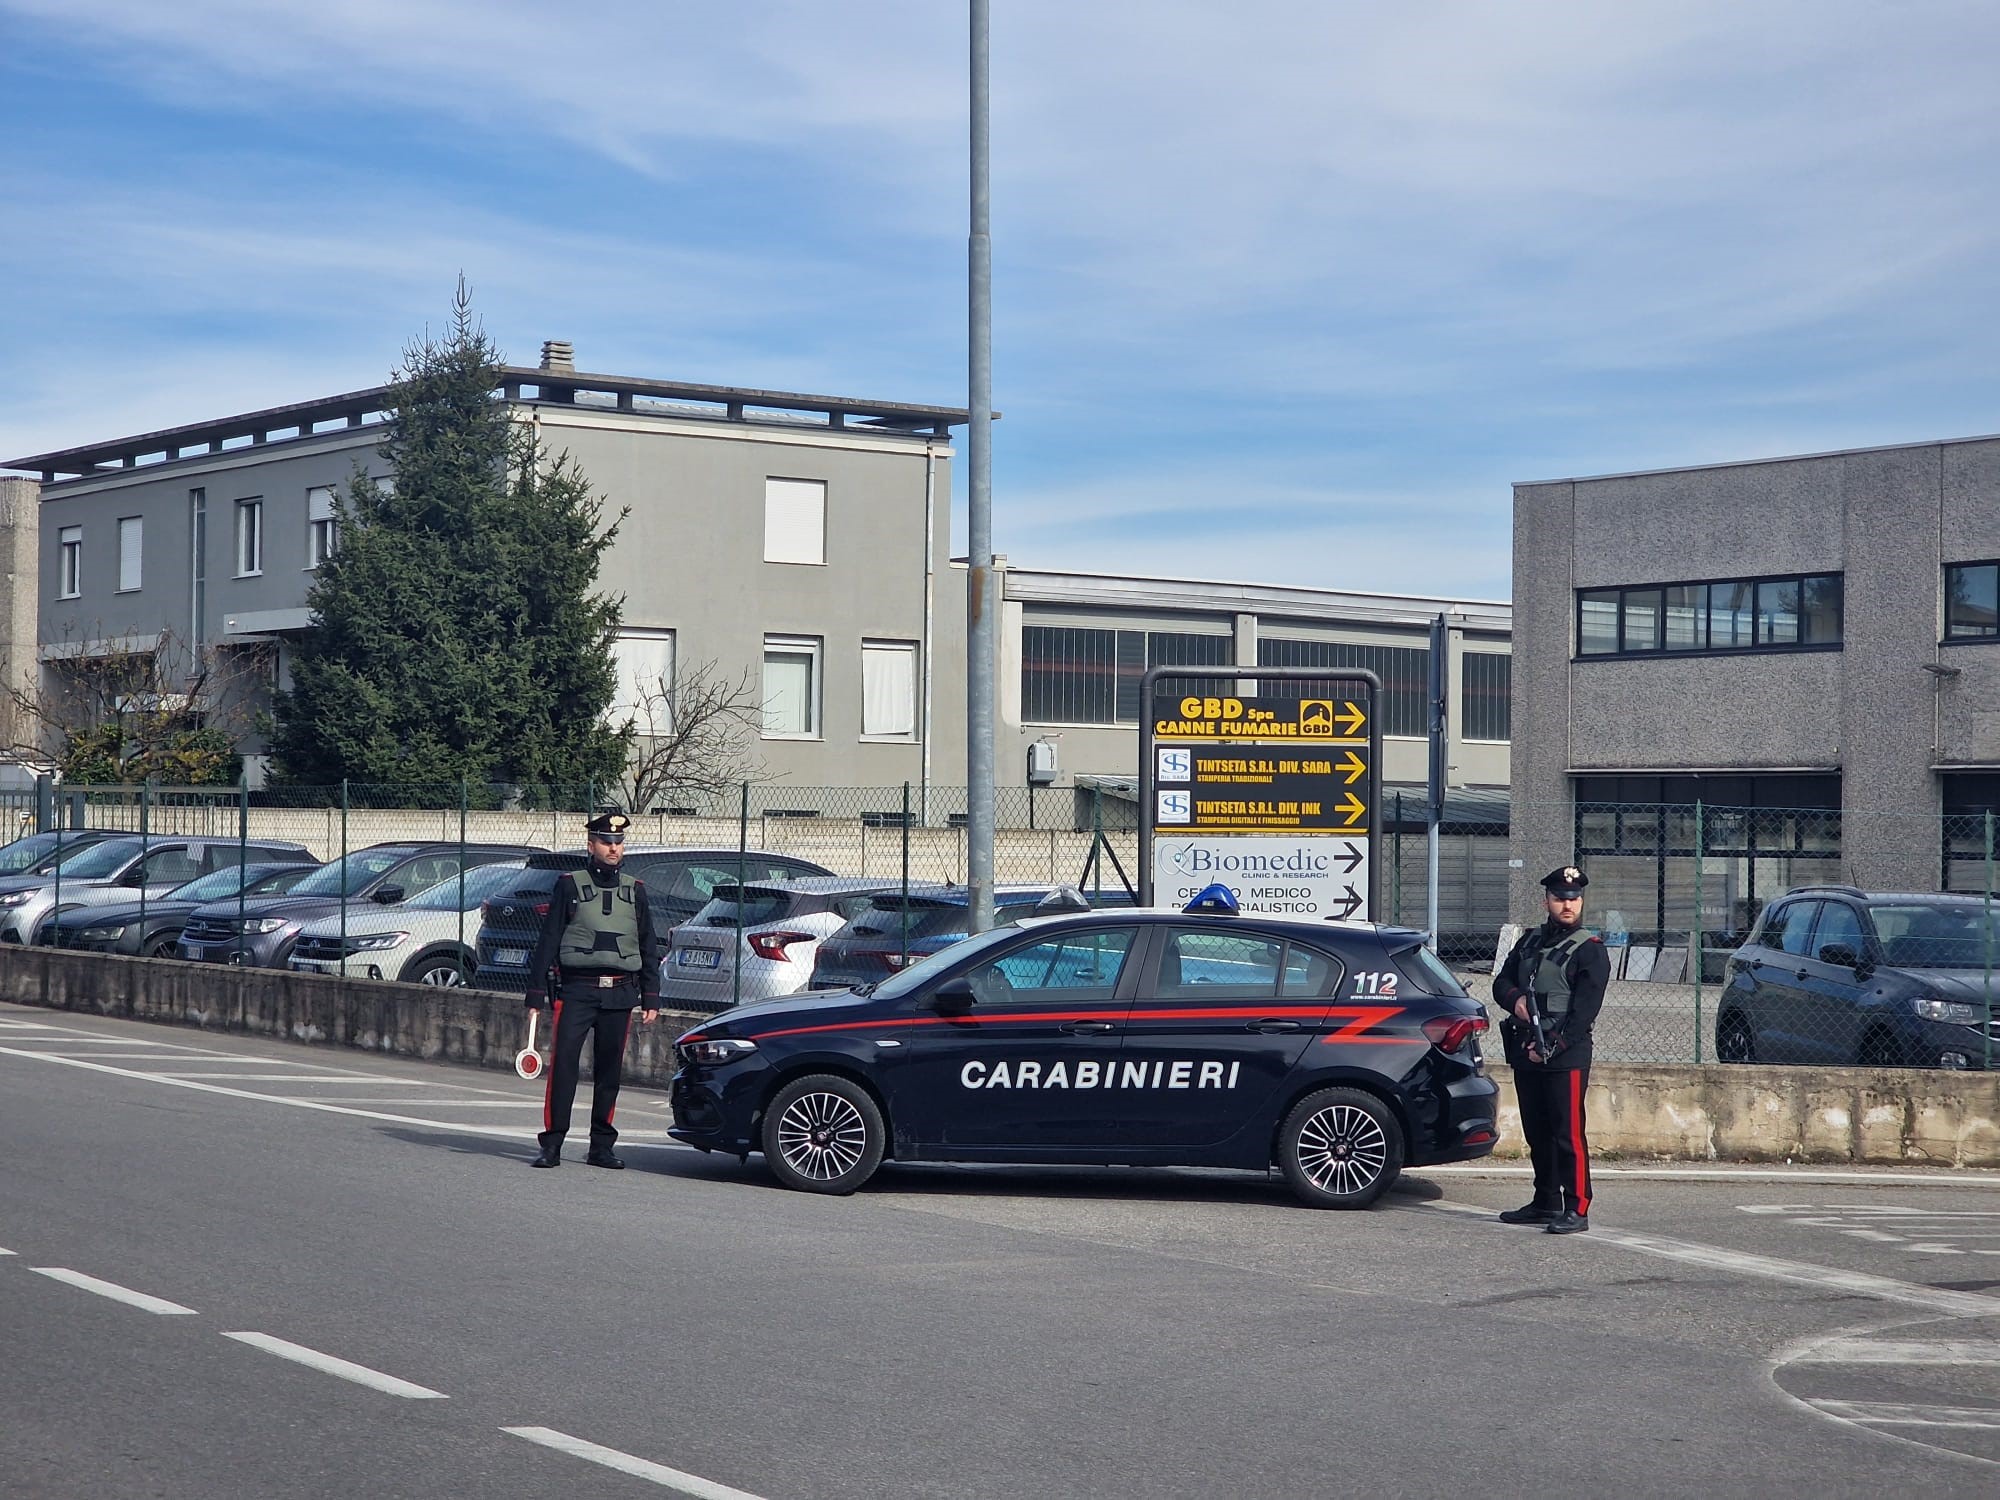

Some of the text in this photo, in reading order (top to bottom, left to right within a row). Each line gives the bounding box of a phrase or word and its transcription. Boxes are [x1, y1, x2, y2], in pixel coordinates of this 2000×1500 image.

[1180, 697, 1274, 721] GBD Spa
[1156, 721, 1297, 735] CANNE FUMARIE
[1302, 724, 1331, 734] GBD
[1196, 759, 1331, 774] TINTSETA S.R.L. DIV. SARA
[1196, 801, 1321, 815] TINTSETA S.R.L. DIV. INK
[1192, 848, 1329, 871] Biomedic
[1250, 887, 1312, 899] MEDICO
[1353, 971, 1398, 995] 112
[960, 1060, 1241, 1089] CARABINIERI
